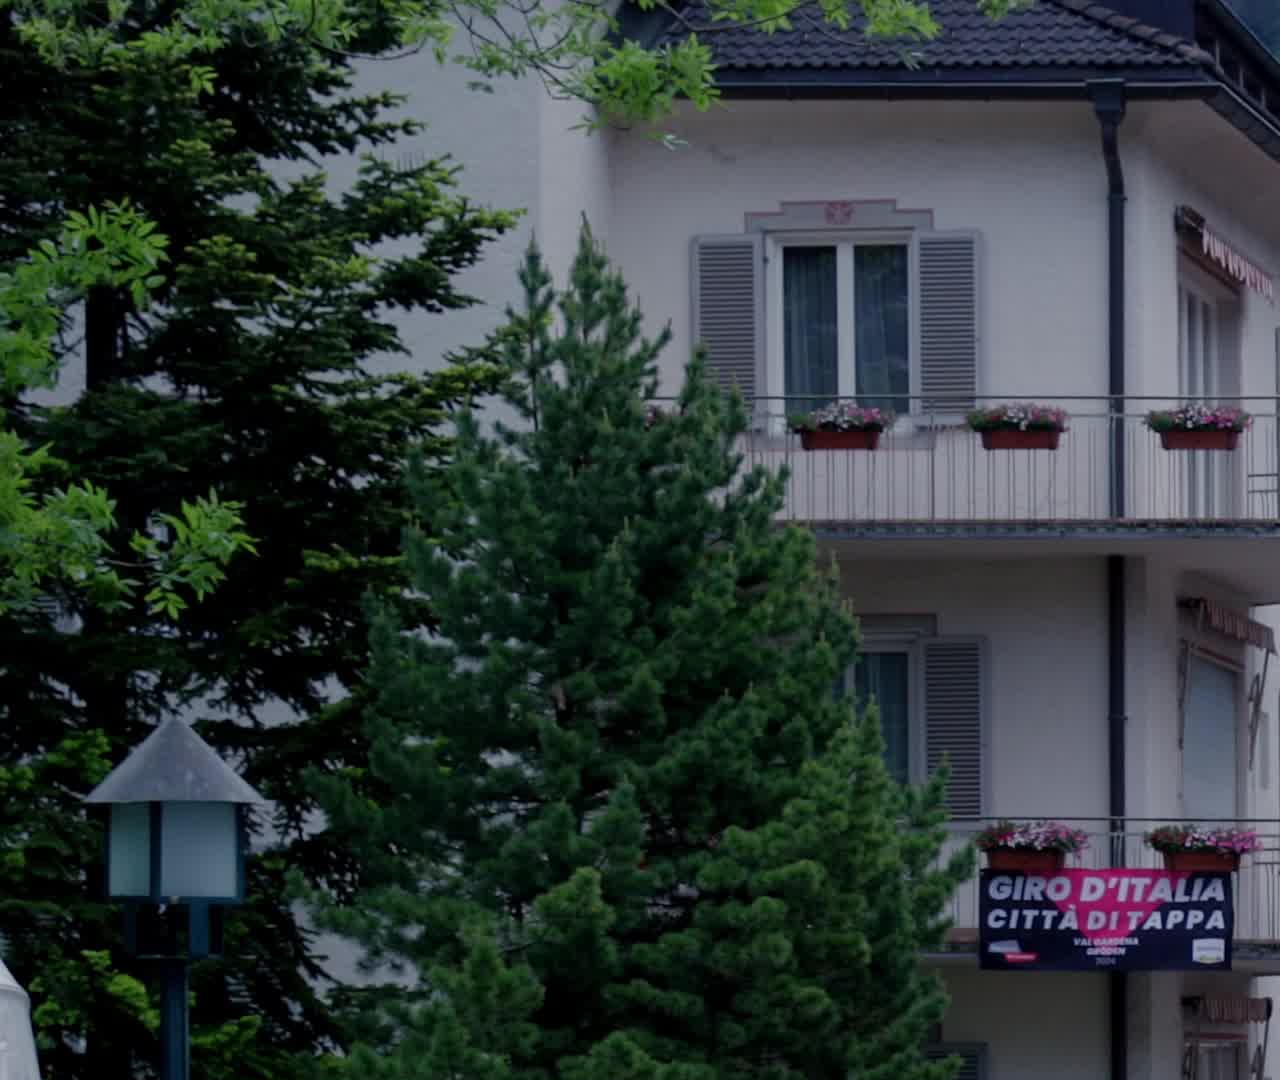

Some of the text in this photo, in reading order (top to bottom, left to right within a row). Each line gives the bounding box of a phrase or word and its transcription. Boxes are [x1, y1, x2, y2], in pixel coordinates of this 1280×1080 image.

[987, 875, 1226, 903] GIRO D'ITALIA
[987, 904, 1226, 931] CITTÀ DI TAPPA
[1073, 936, 1092, 946] VAL
